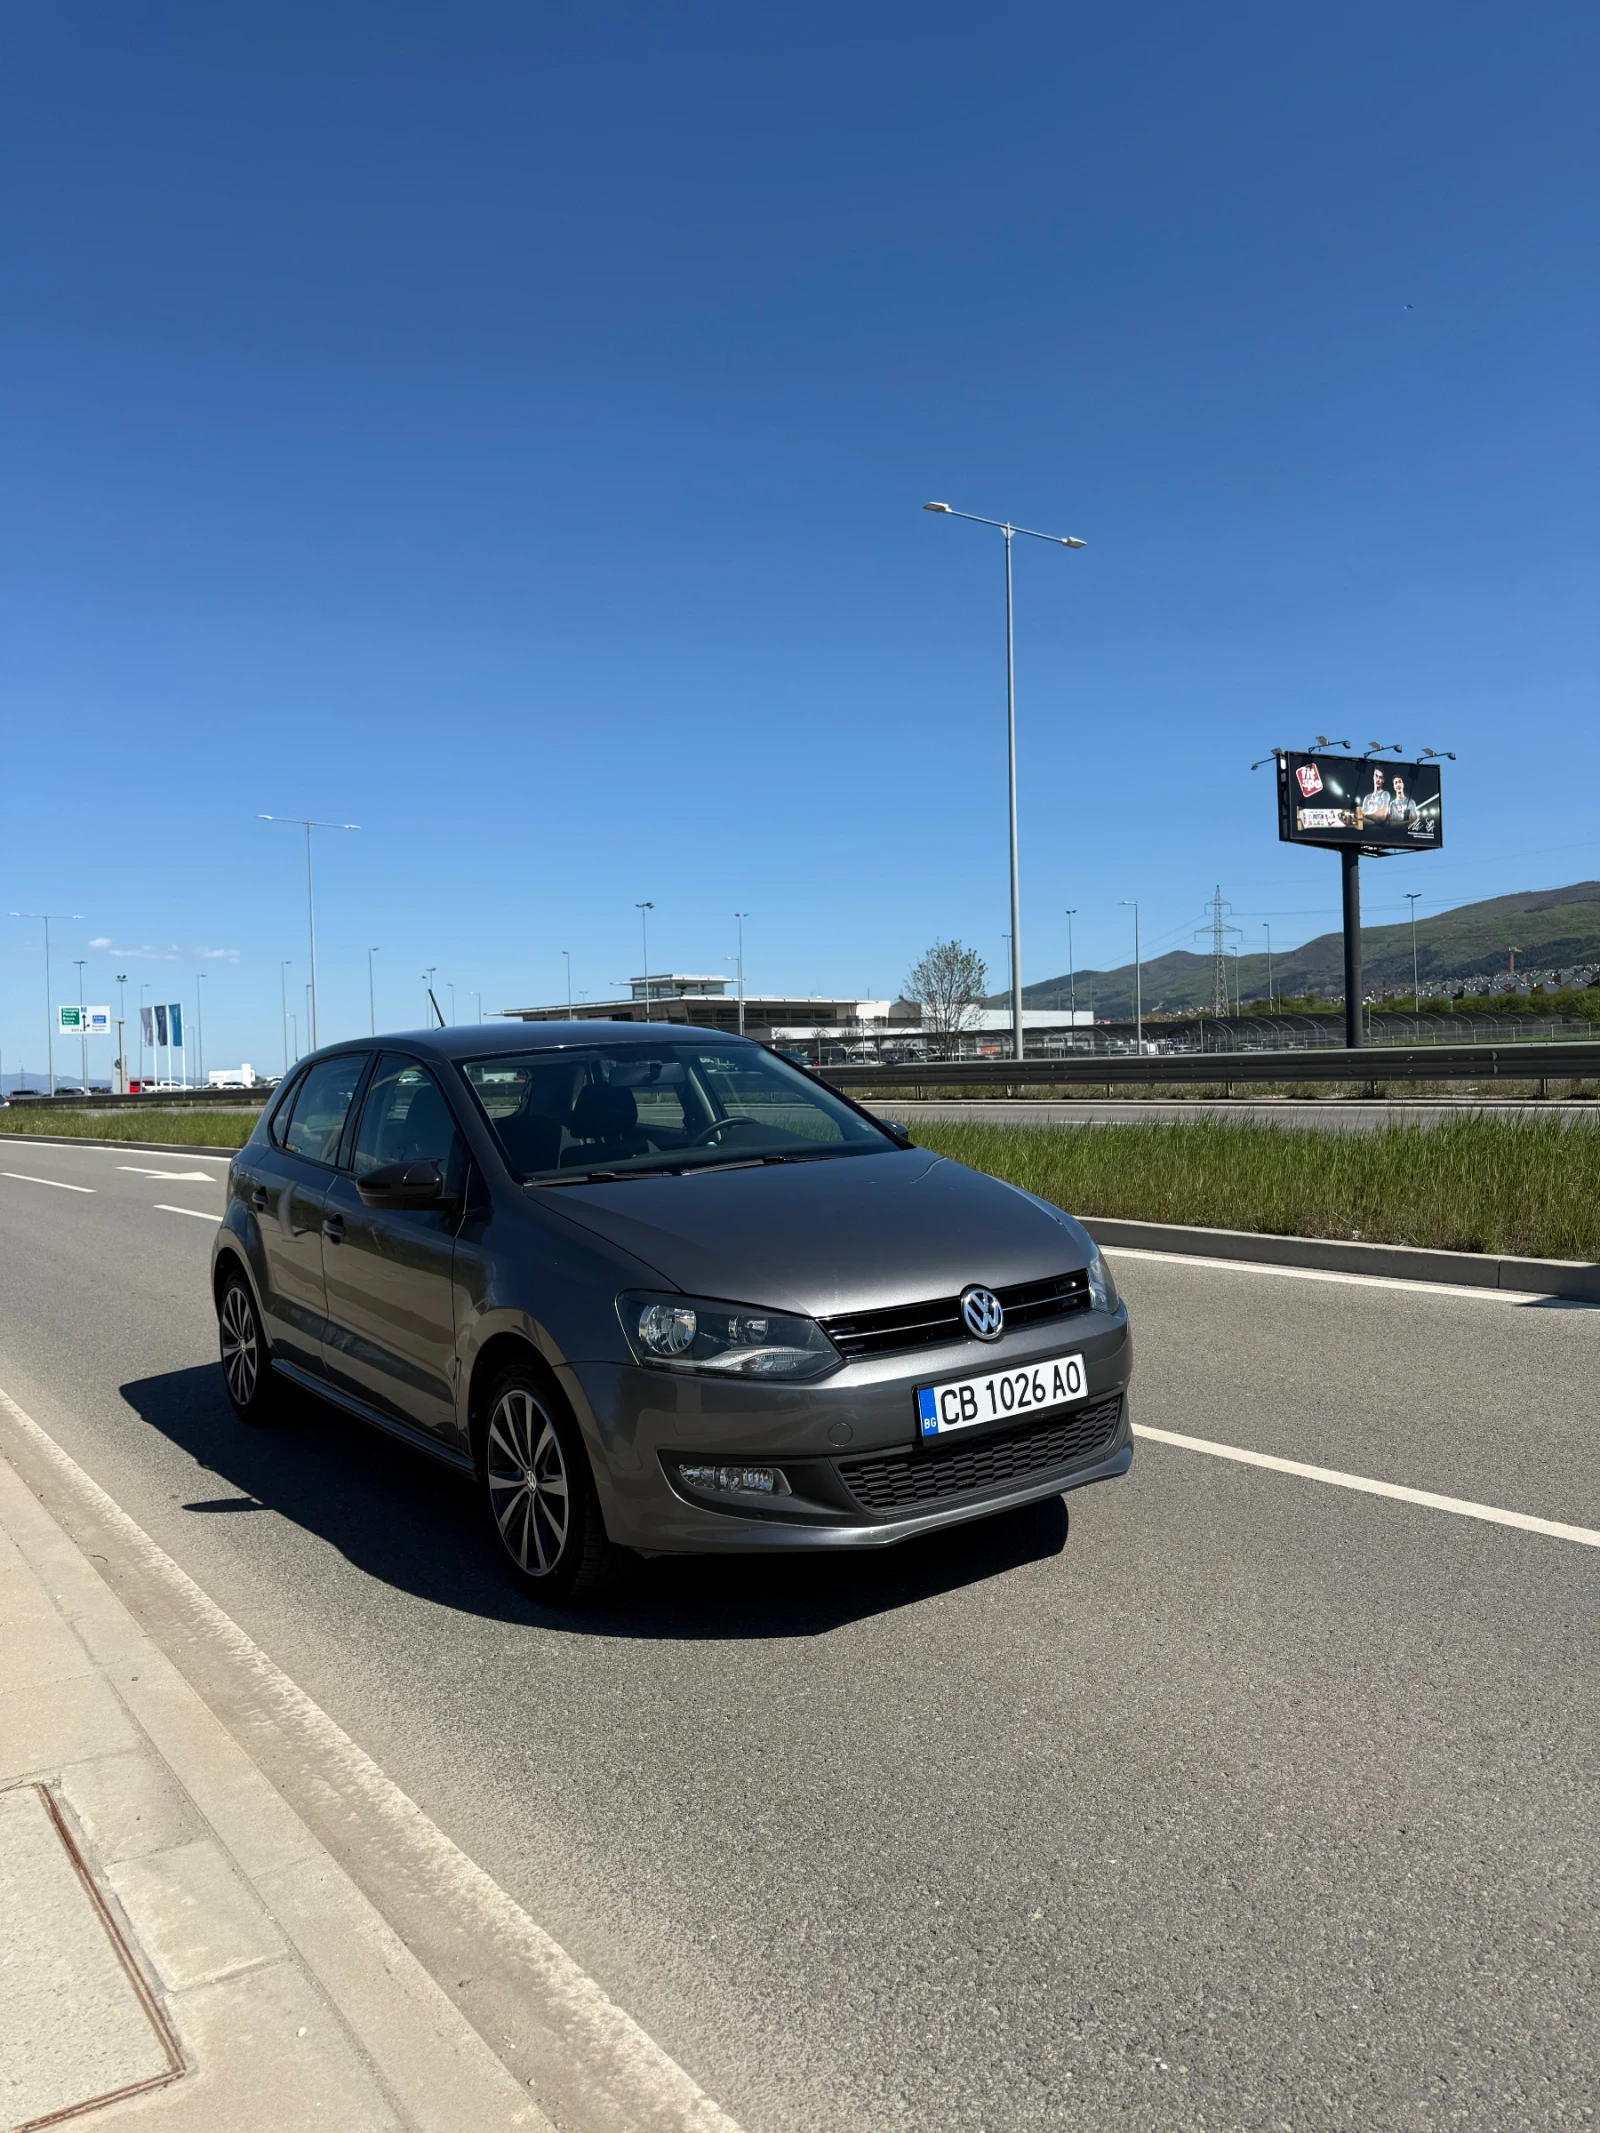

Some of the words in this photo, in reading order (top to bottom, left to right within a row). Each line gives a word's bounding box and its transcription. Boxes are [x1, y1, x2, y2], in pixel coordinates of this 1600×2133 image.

[940, 1385, 978, 1425] CB
[986, 1369, 1046, 1415] 1026
[1052, 1361, 1081, 1399] AO
[924, 1417, 937, 1430] BG
